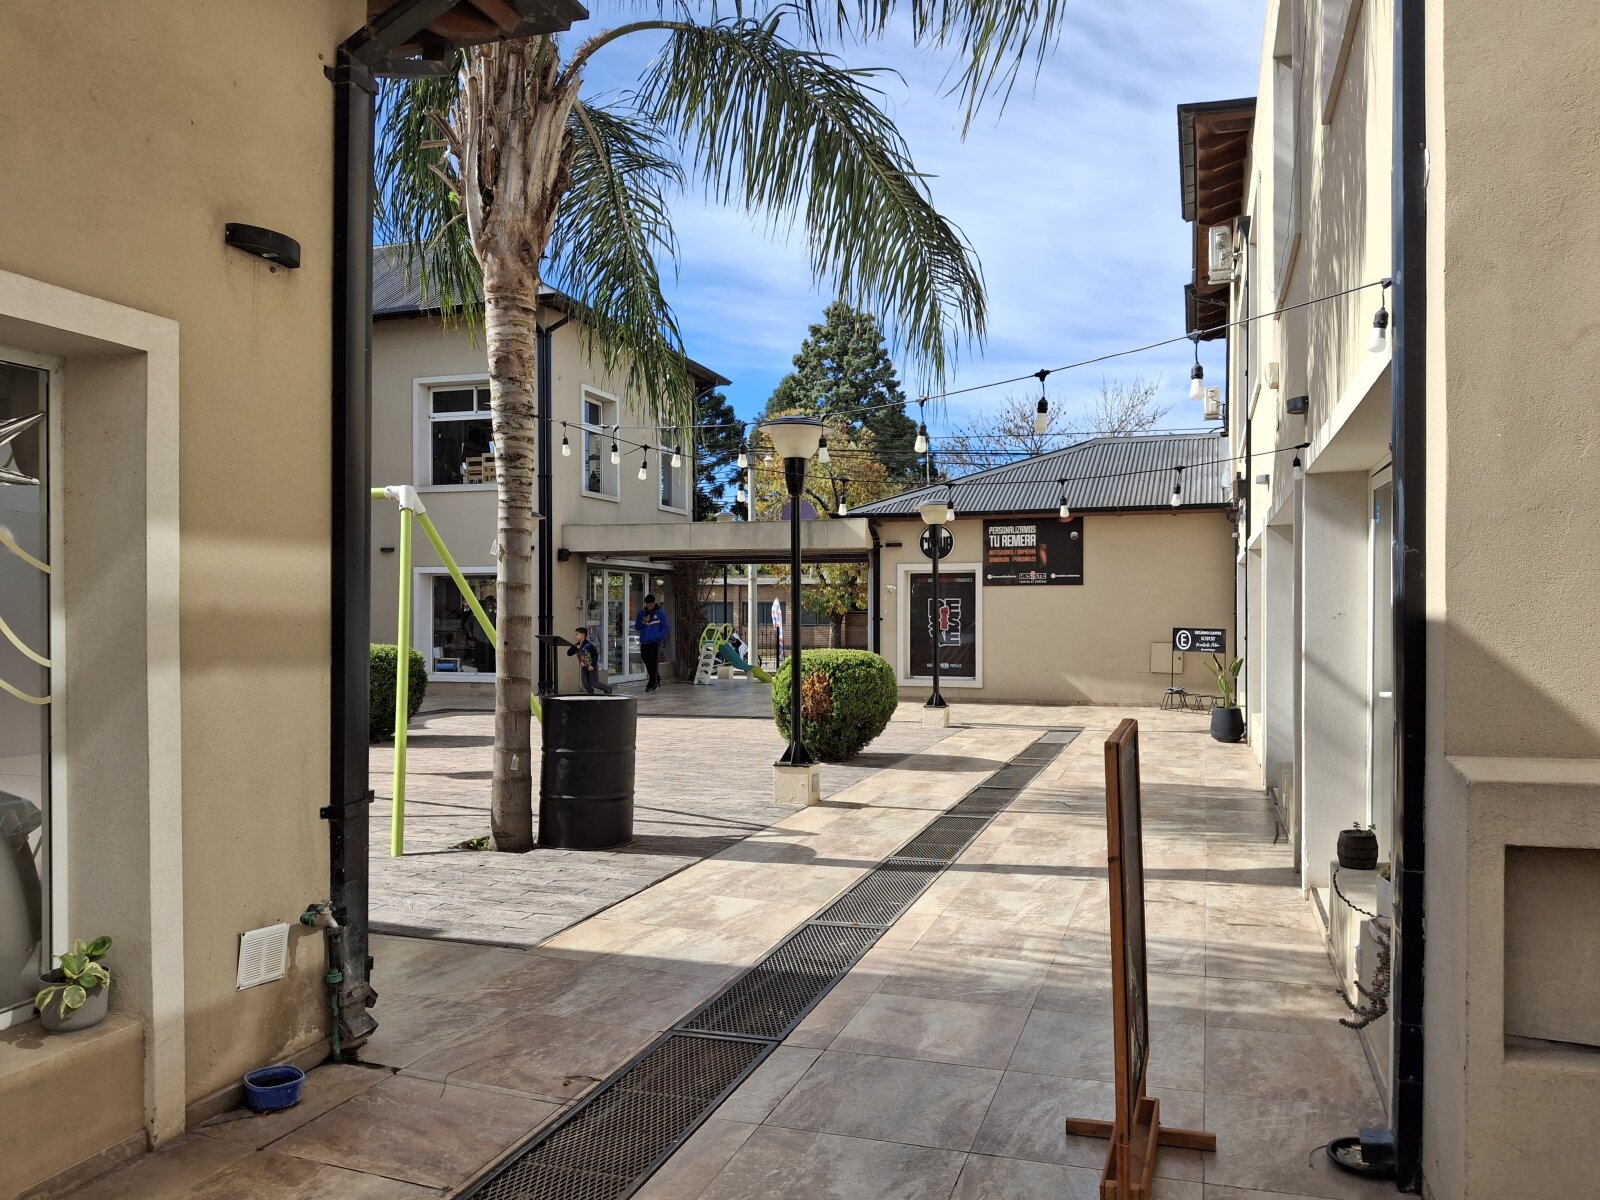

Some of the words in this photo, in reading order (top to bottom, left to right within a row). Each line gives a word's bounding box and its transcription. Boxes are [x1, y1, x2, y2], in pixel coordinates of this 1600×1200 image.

[988, 525, 1037, 534] PERSONALIZAMOS
[988, 534, 1000, 548] TU
[1001, 533, 1037, 547] REMERA
[1181, 634, 1187, 646] E
